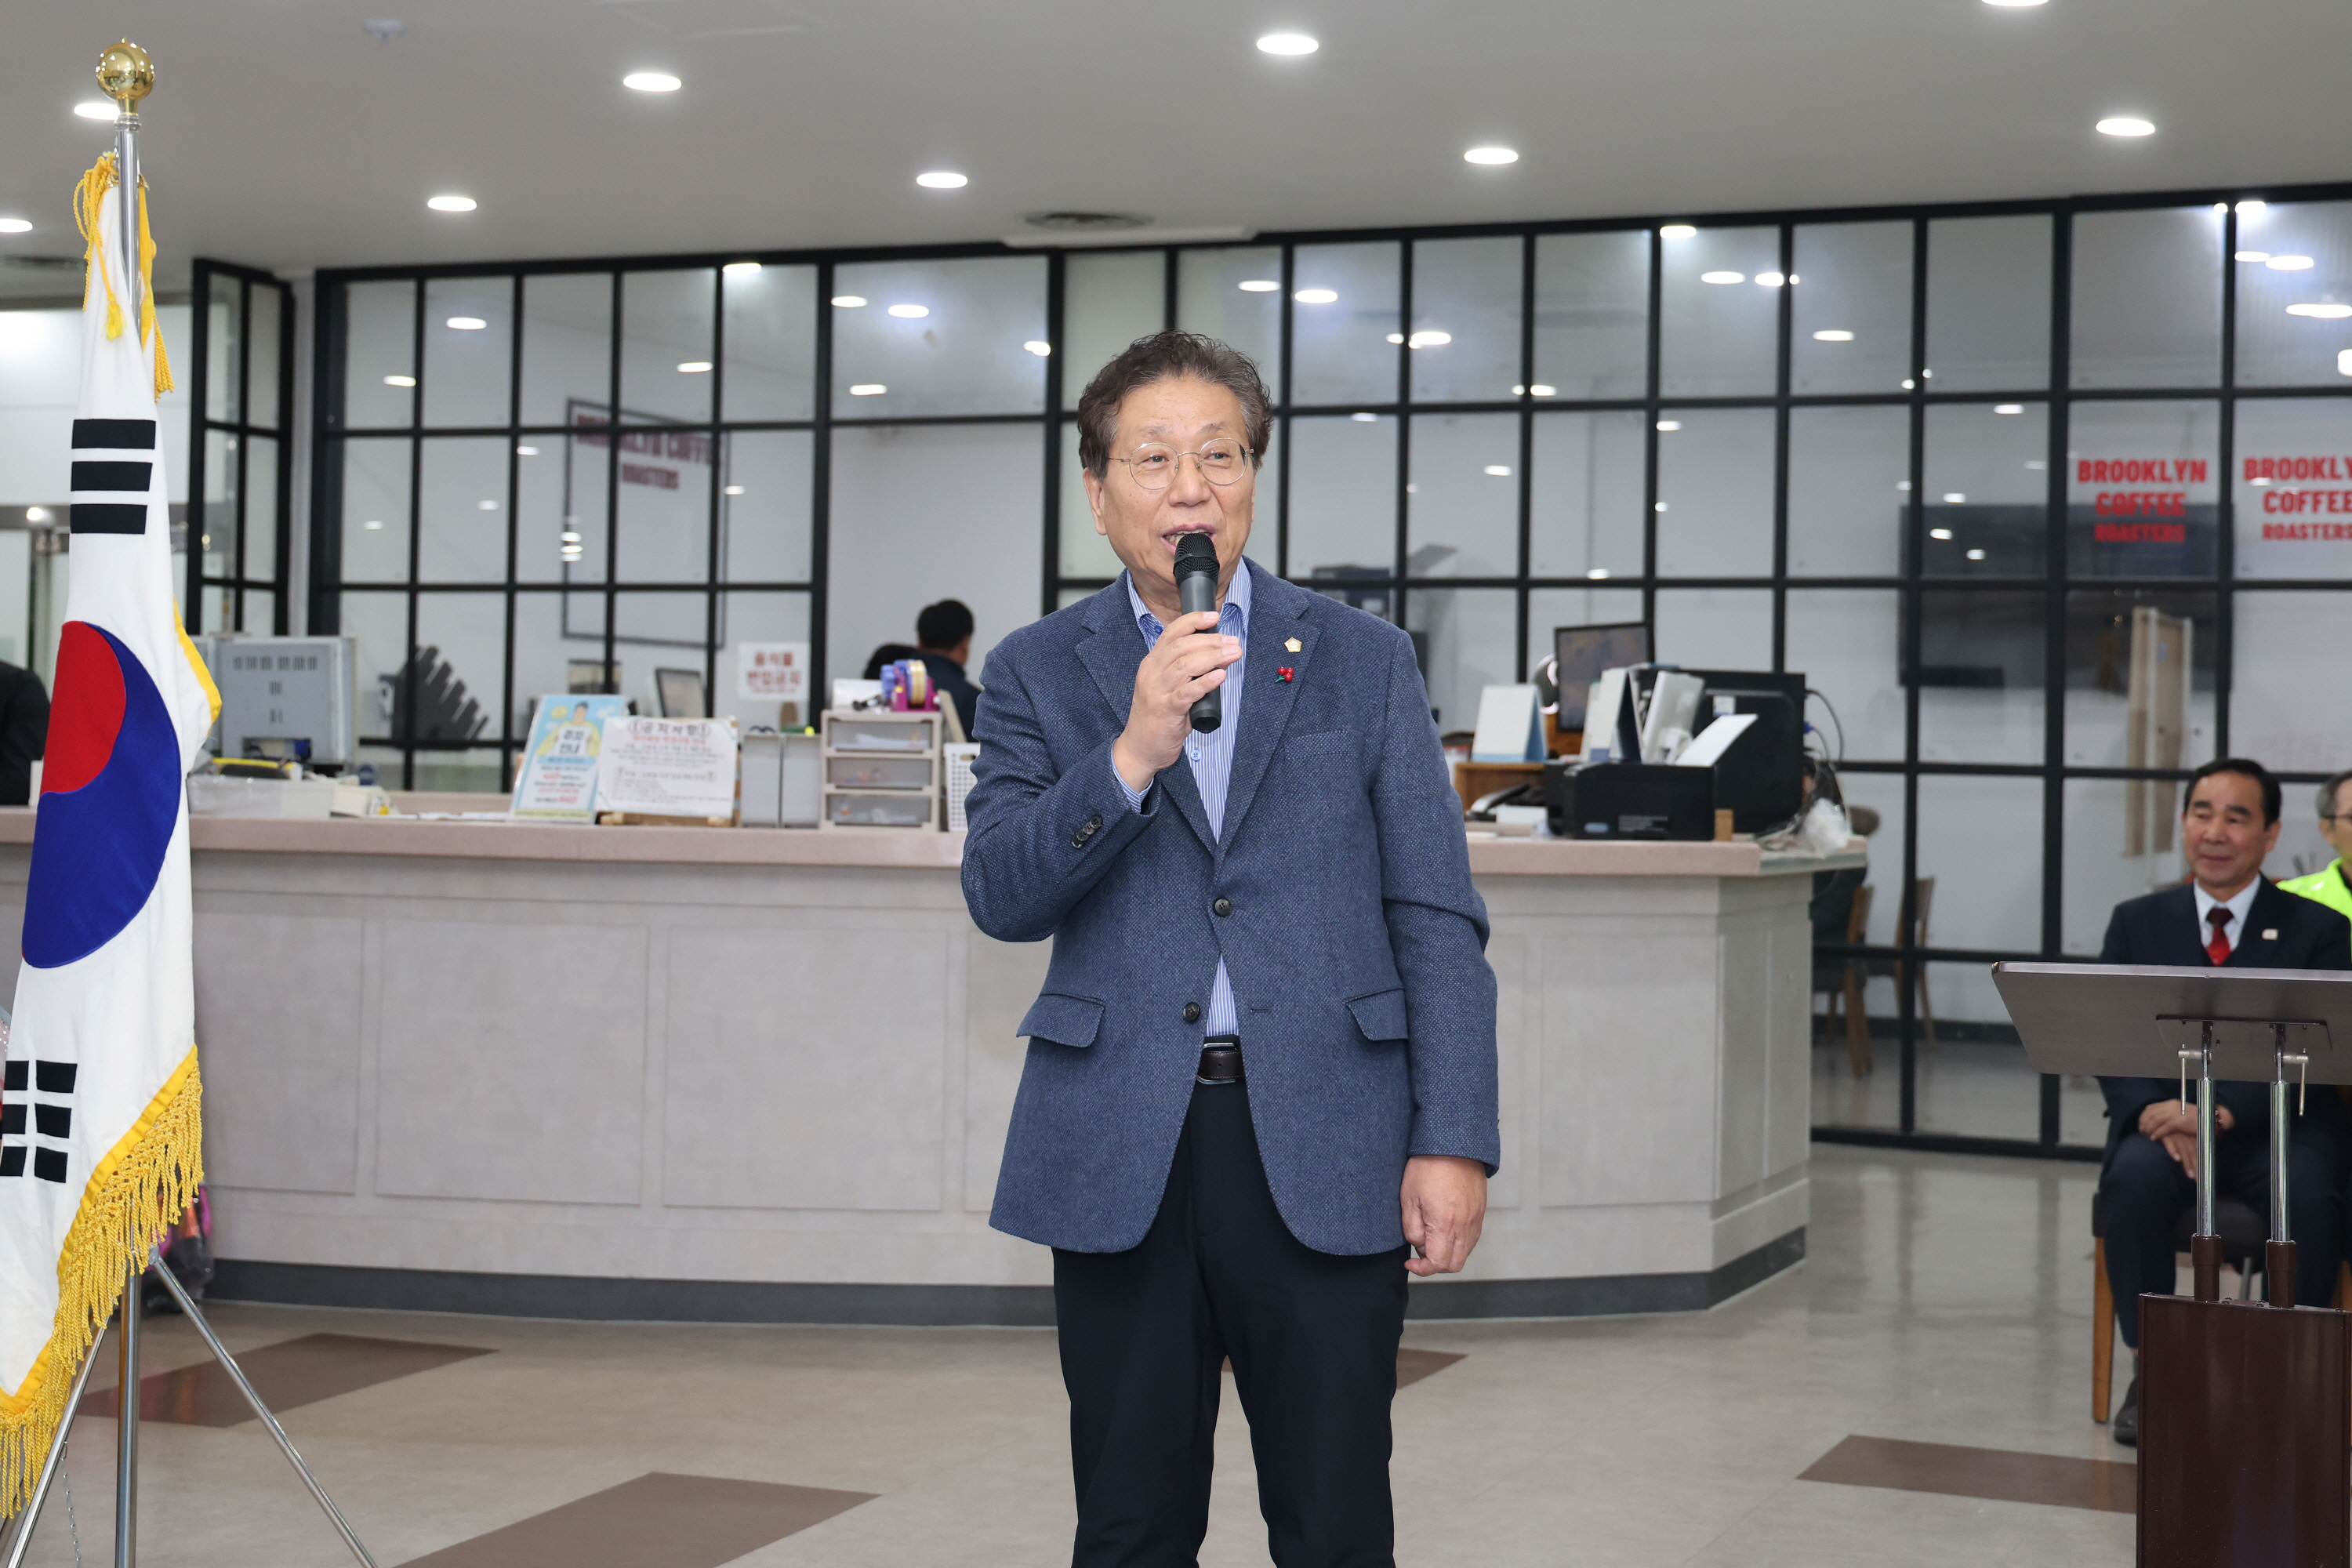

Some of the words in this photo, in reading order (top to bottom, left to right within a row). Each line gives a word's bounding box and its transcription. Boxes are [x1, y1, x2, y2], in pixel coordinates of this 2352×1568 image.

[2078, 459, 2208, 483] BROOKLYN
[2095, 492, 2187, 517] COFFEE
[2263, 490, 2352, 514] COFFEE
[2093, 523, 2186, 543] ROASTERS
